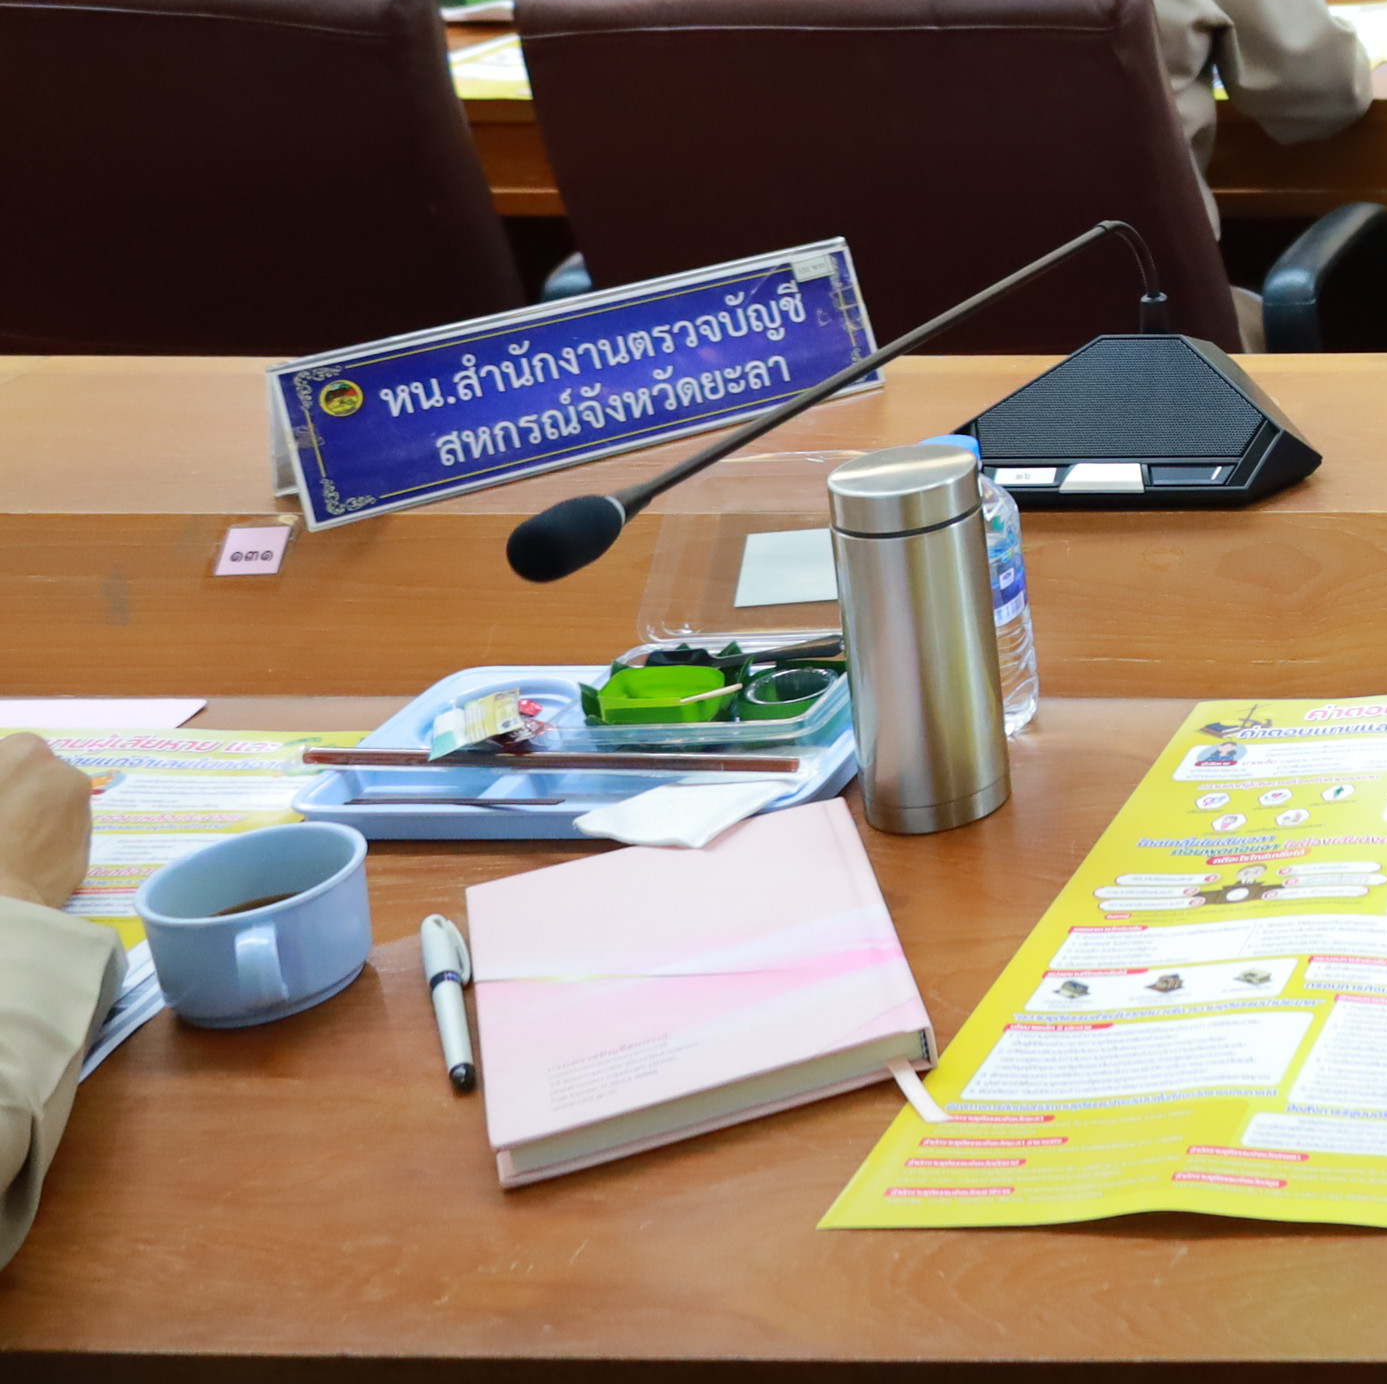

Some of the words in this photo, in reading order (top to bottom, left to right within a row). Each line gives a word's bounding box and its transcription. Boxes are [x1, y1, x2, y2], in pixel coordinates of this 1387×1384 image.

[380, 281, 807, 419] หน.สำนักงานตรวจบัญชี
[436, 353, 791, 467] สหกรณ์จังหวัดยะลา
[229, 546, 275, 564] ๑๓๑
[222, 741, 281, 753] และ
